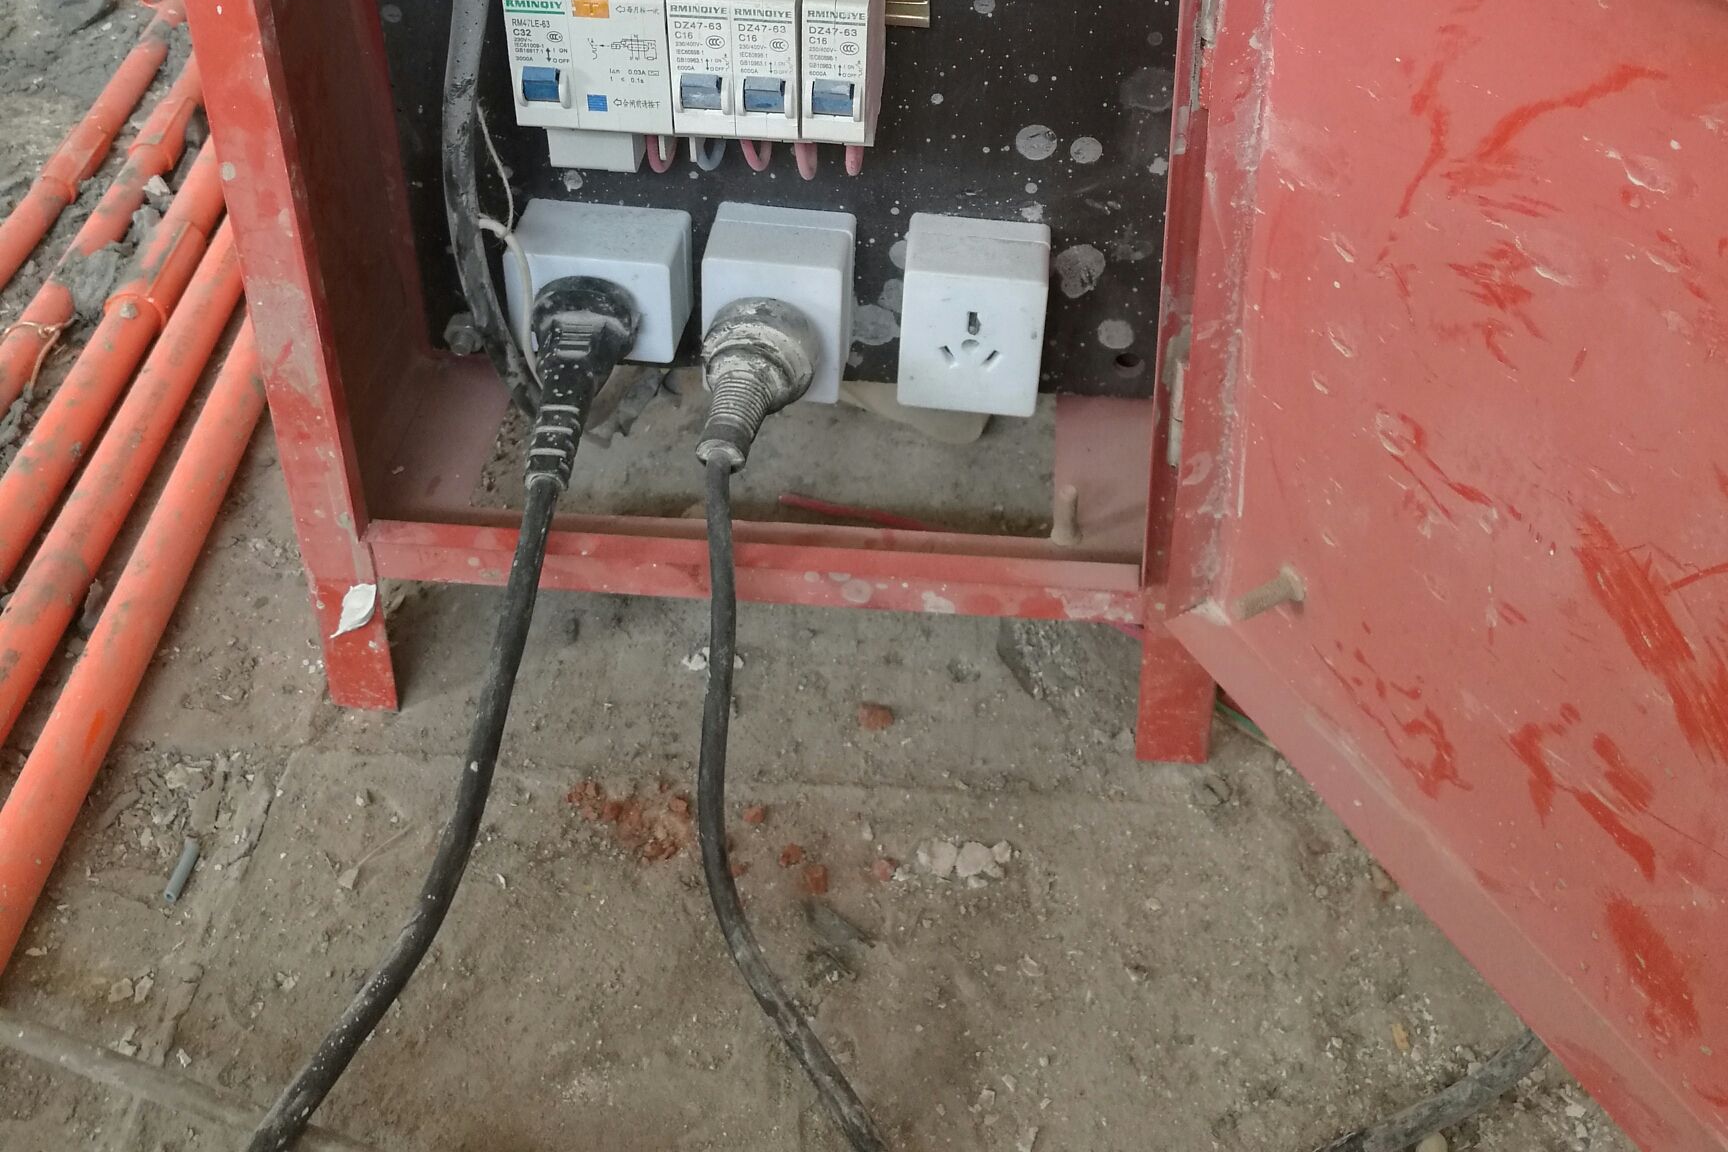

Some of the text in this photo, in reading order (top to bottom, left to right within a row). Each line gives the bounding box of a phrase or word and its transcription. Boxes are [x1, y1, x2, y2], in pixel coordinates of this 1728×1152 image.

[505, 0, 562, 9] RMINQIY
[670, 4, 728, 14] RMINQIYE
[734, 8, 792, 18] RMINQIYE
[674, 21, 722, 30] DZ47-63
[738, 23, 786, 33] DZ47-63
[512, 28, 532, 37] C32
[674, 31, 694, 40] C16
[808, 26, 858, 36] DZ47-63
[738, 34, 758, 42] C16
[808, 36, 828, 45] C16
